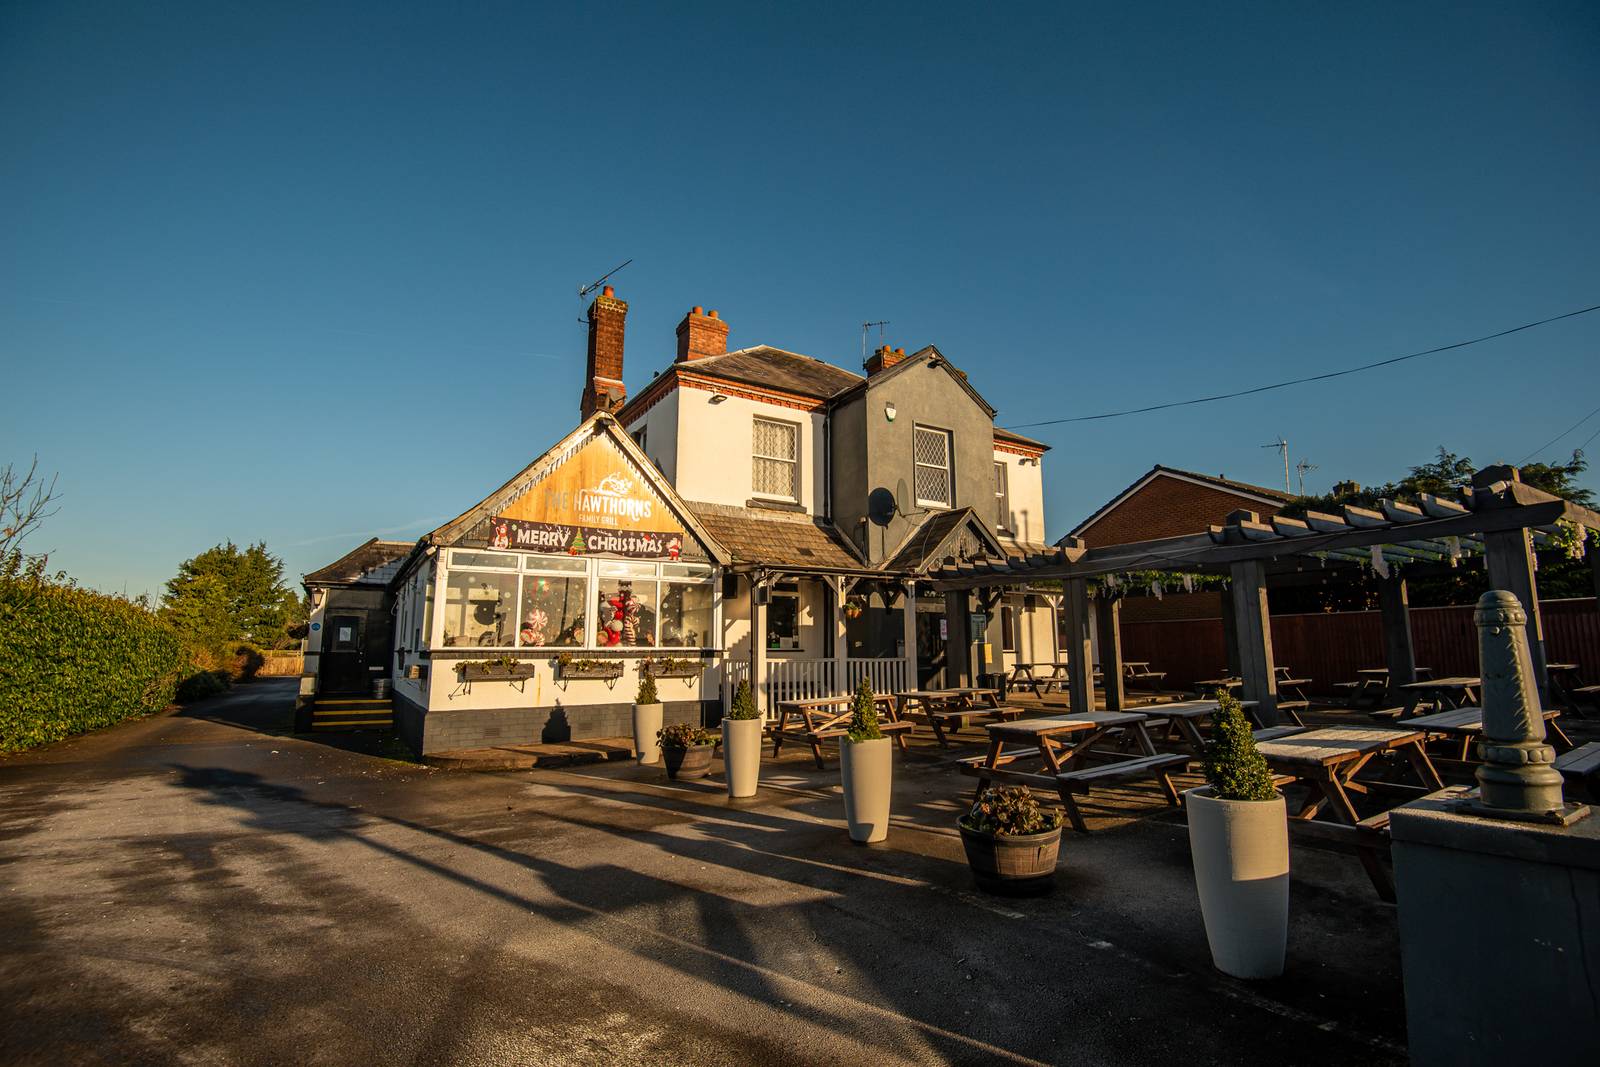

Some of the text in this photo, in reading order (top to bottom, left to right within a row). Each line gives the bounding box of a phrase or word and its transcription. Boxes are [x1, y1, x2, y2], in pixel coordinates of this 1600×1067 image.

[544, 489, 652, 522] THE HAWTHORNS
[578, 514, 618, 526] FAMILY GRILL
[516, 527, 663, 554] MERRY CHRISTMAS
